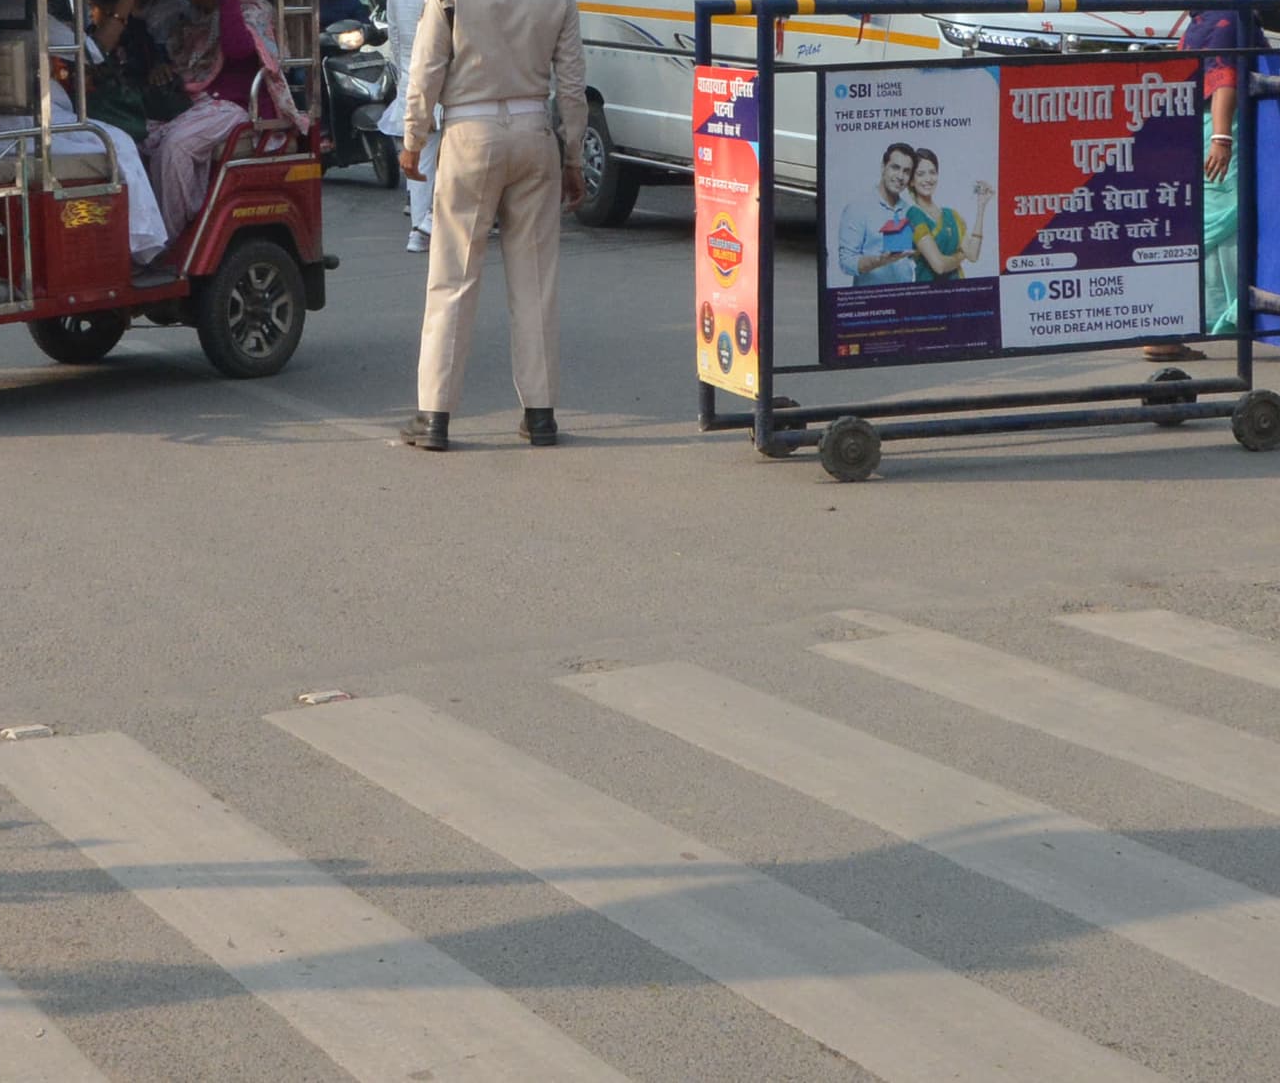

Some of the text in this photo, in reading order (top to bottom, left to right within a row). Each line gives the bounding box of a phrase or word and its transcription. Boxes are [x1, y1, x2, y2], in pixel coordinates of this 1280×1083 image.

[797, 43, 822, 58] Pilot
[849, 84, 871, 98] SBI
[877, 82, 902, 90] HOME
[877, 89, 902, 97] LOANS
[713, 101, 734, 118] पटना
[1009, 72, 1196, 132] यातायात पुलिस
[835, 106, 945, 120] THE BEST TIME TO BUY
[835, 117, 972, 132] YOUR DREAM HOME IS NOW!
[1070, 137, 1135, 175] पटना
[1013, 186, 1095, 216] आपकी
[1102, 185, 1148, 211] सेवा
[1138, 246, 1199, 261] Year: 2023-24
[1048, 279, 1081, 299] SBI
[1089, 276, 1124, 287] HOME
[1089, 286, 1124, 297] LOANS
[1029, 304, 1154, 323] THE BEST TIME TO BUY
[1030, 315, 1184, 336] YOUR DREAM HOME IS NOW!
